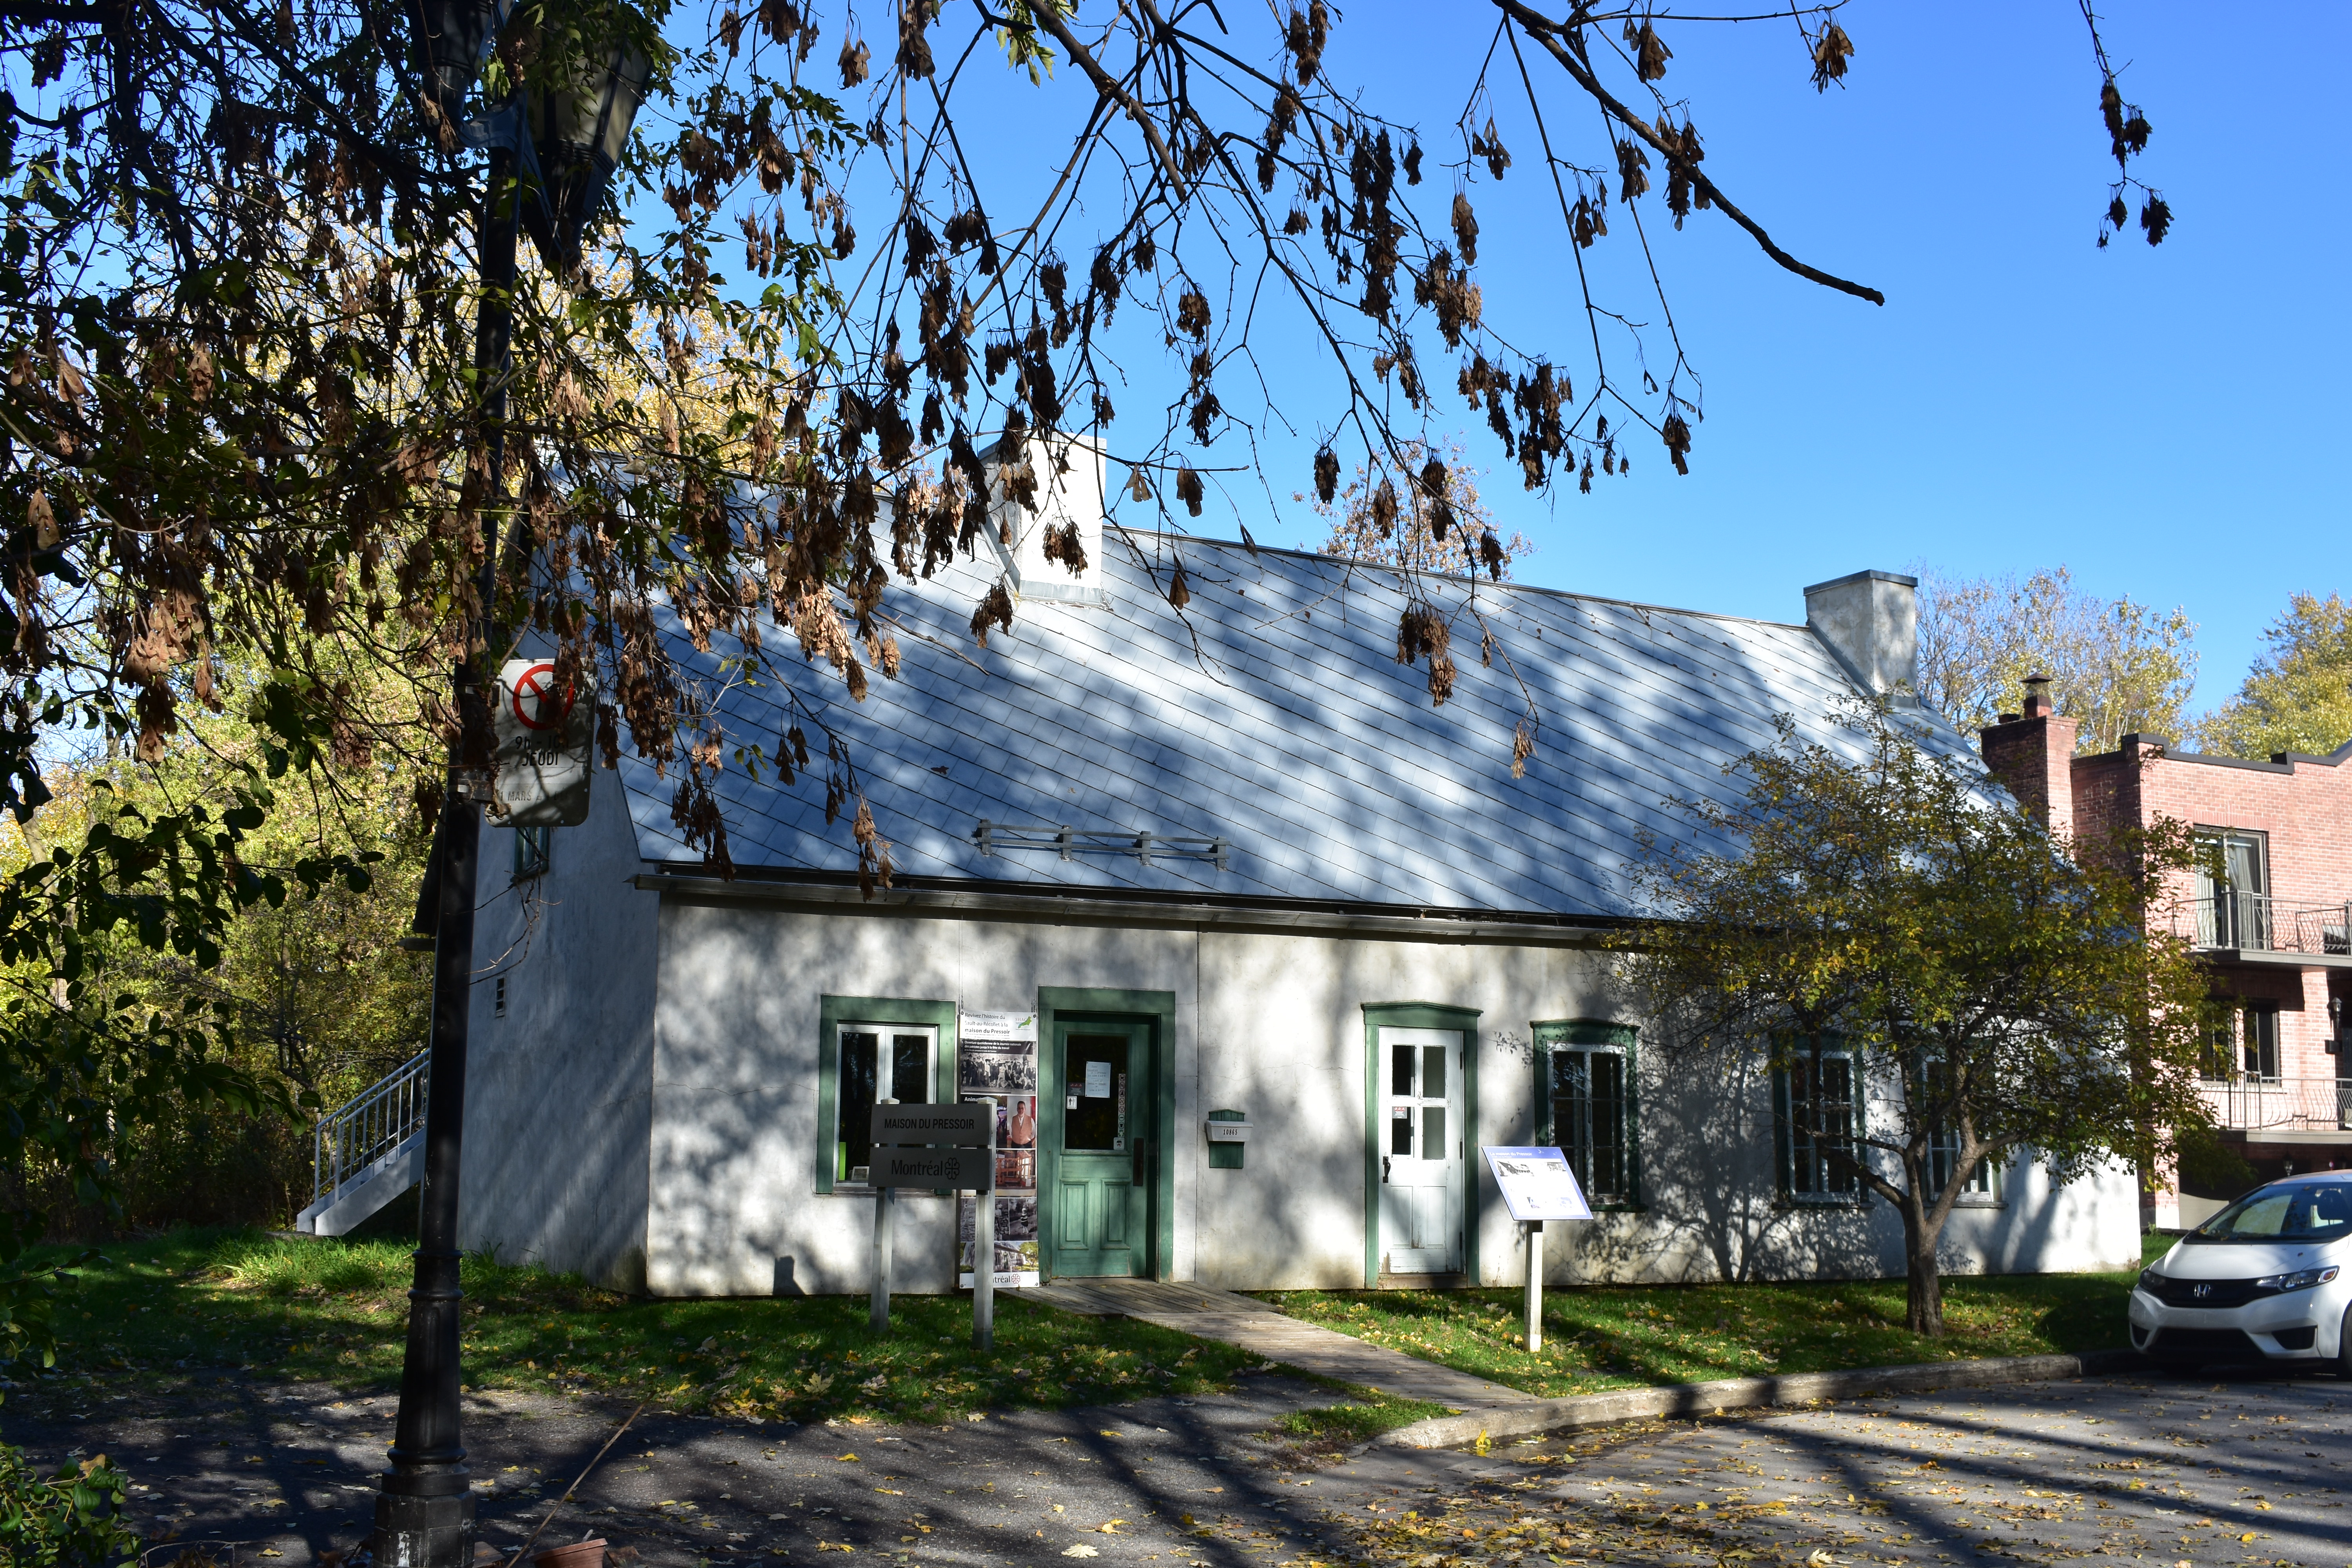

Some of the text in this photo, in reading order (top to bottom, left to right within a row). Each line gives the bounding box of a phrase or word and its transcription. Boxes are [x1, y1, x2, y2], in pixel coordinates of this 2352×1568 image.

[515, 736, 530, 750] 9h
[522, 752, 559, 766] JEUDI
[508, 790, 532, 801] MARS
[884, 1118, 974, 1129] MAISON DU PRESSOIR
[891, 1160, 943, 1176] Montréal
